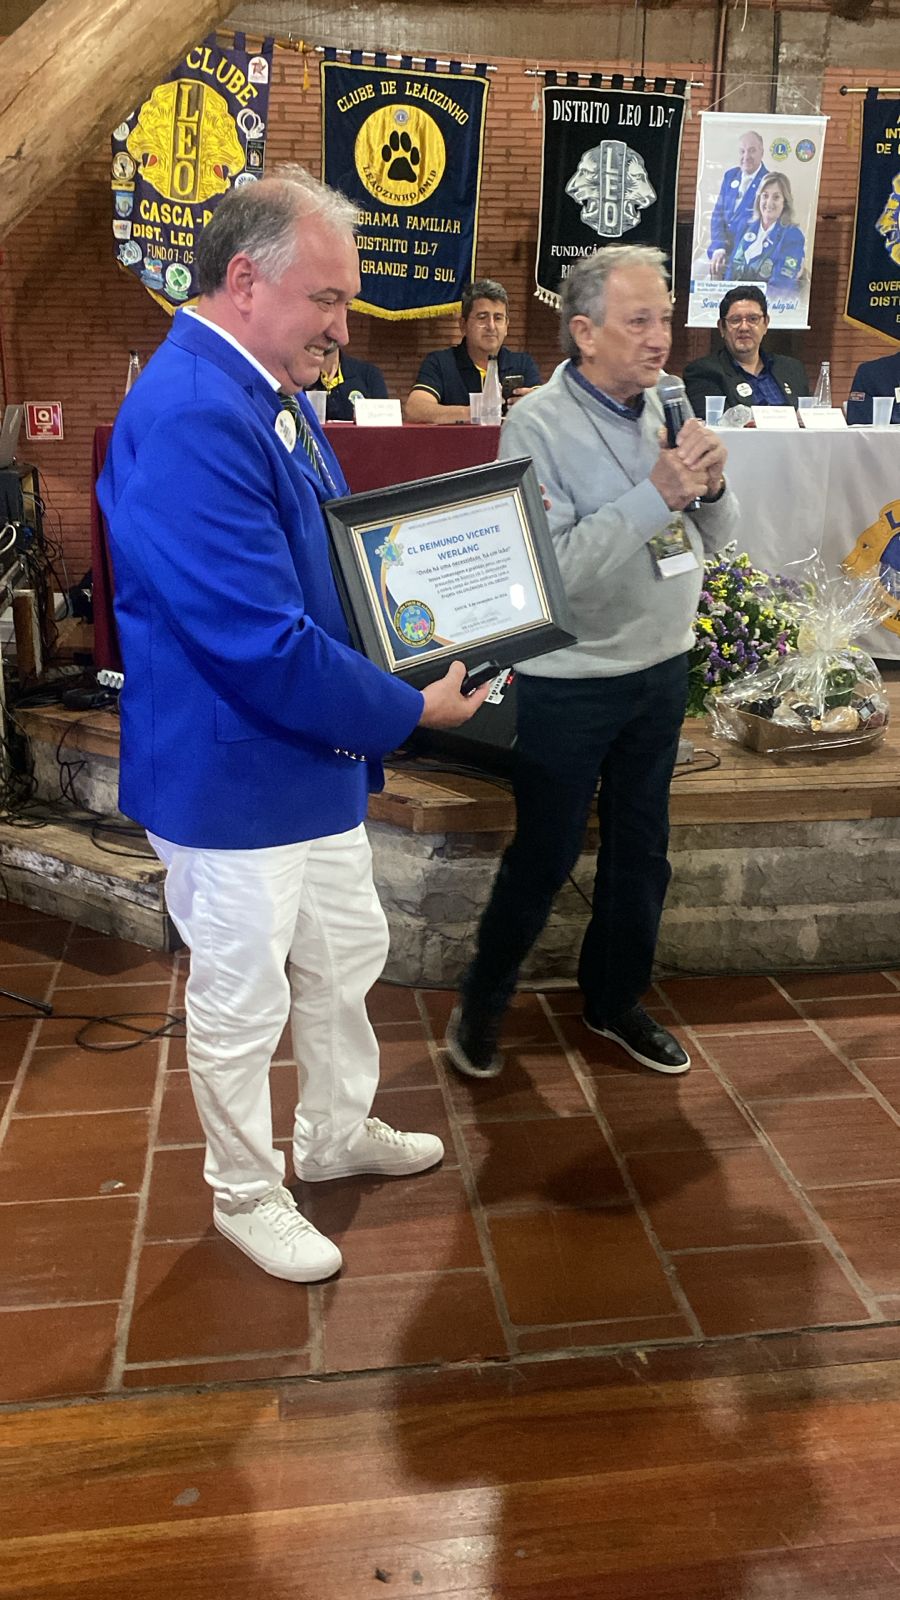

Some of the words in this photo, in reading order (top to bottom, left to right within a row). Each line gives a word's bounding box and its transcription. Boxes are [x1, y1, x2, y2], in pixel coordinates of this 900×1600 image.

[186, 46, 258, 107] CLUBE
[337, 83, 375, 113] CLUBE
[380, 80, 397, 95] DE
[552, 99, 610, 125] DISTRITO
[618, 103, 642, 126] LEO
[648, 105, 675, 129] LD-7
[173, 84, 199, 195] LEO
[604, 147, 619, 227] LEO
[132, 223, 164, 243] DIST.
[170, 230, 194, 248] LEO
[356, 210, 400, 228] GRAMA
[406, 215, 461, 234] FAMILIAR
[356, 235, 408, 254] DISTRITO
[414, 240, 439, 256] LD-7
[361, 259, 408, 277] GRANDE
[413, 264, 429, 280] DO
[434, 267, 456, 283] SUL
[407, 546, 418, 555] CL
[419, 534, 465, 553] REIMUNDO
[466, 524, 501, 540] VICENTE
[437, 543, 480, 561] WERLANG
